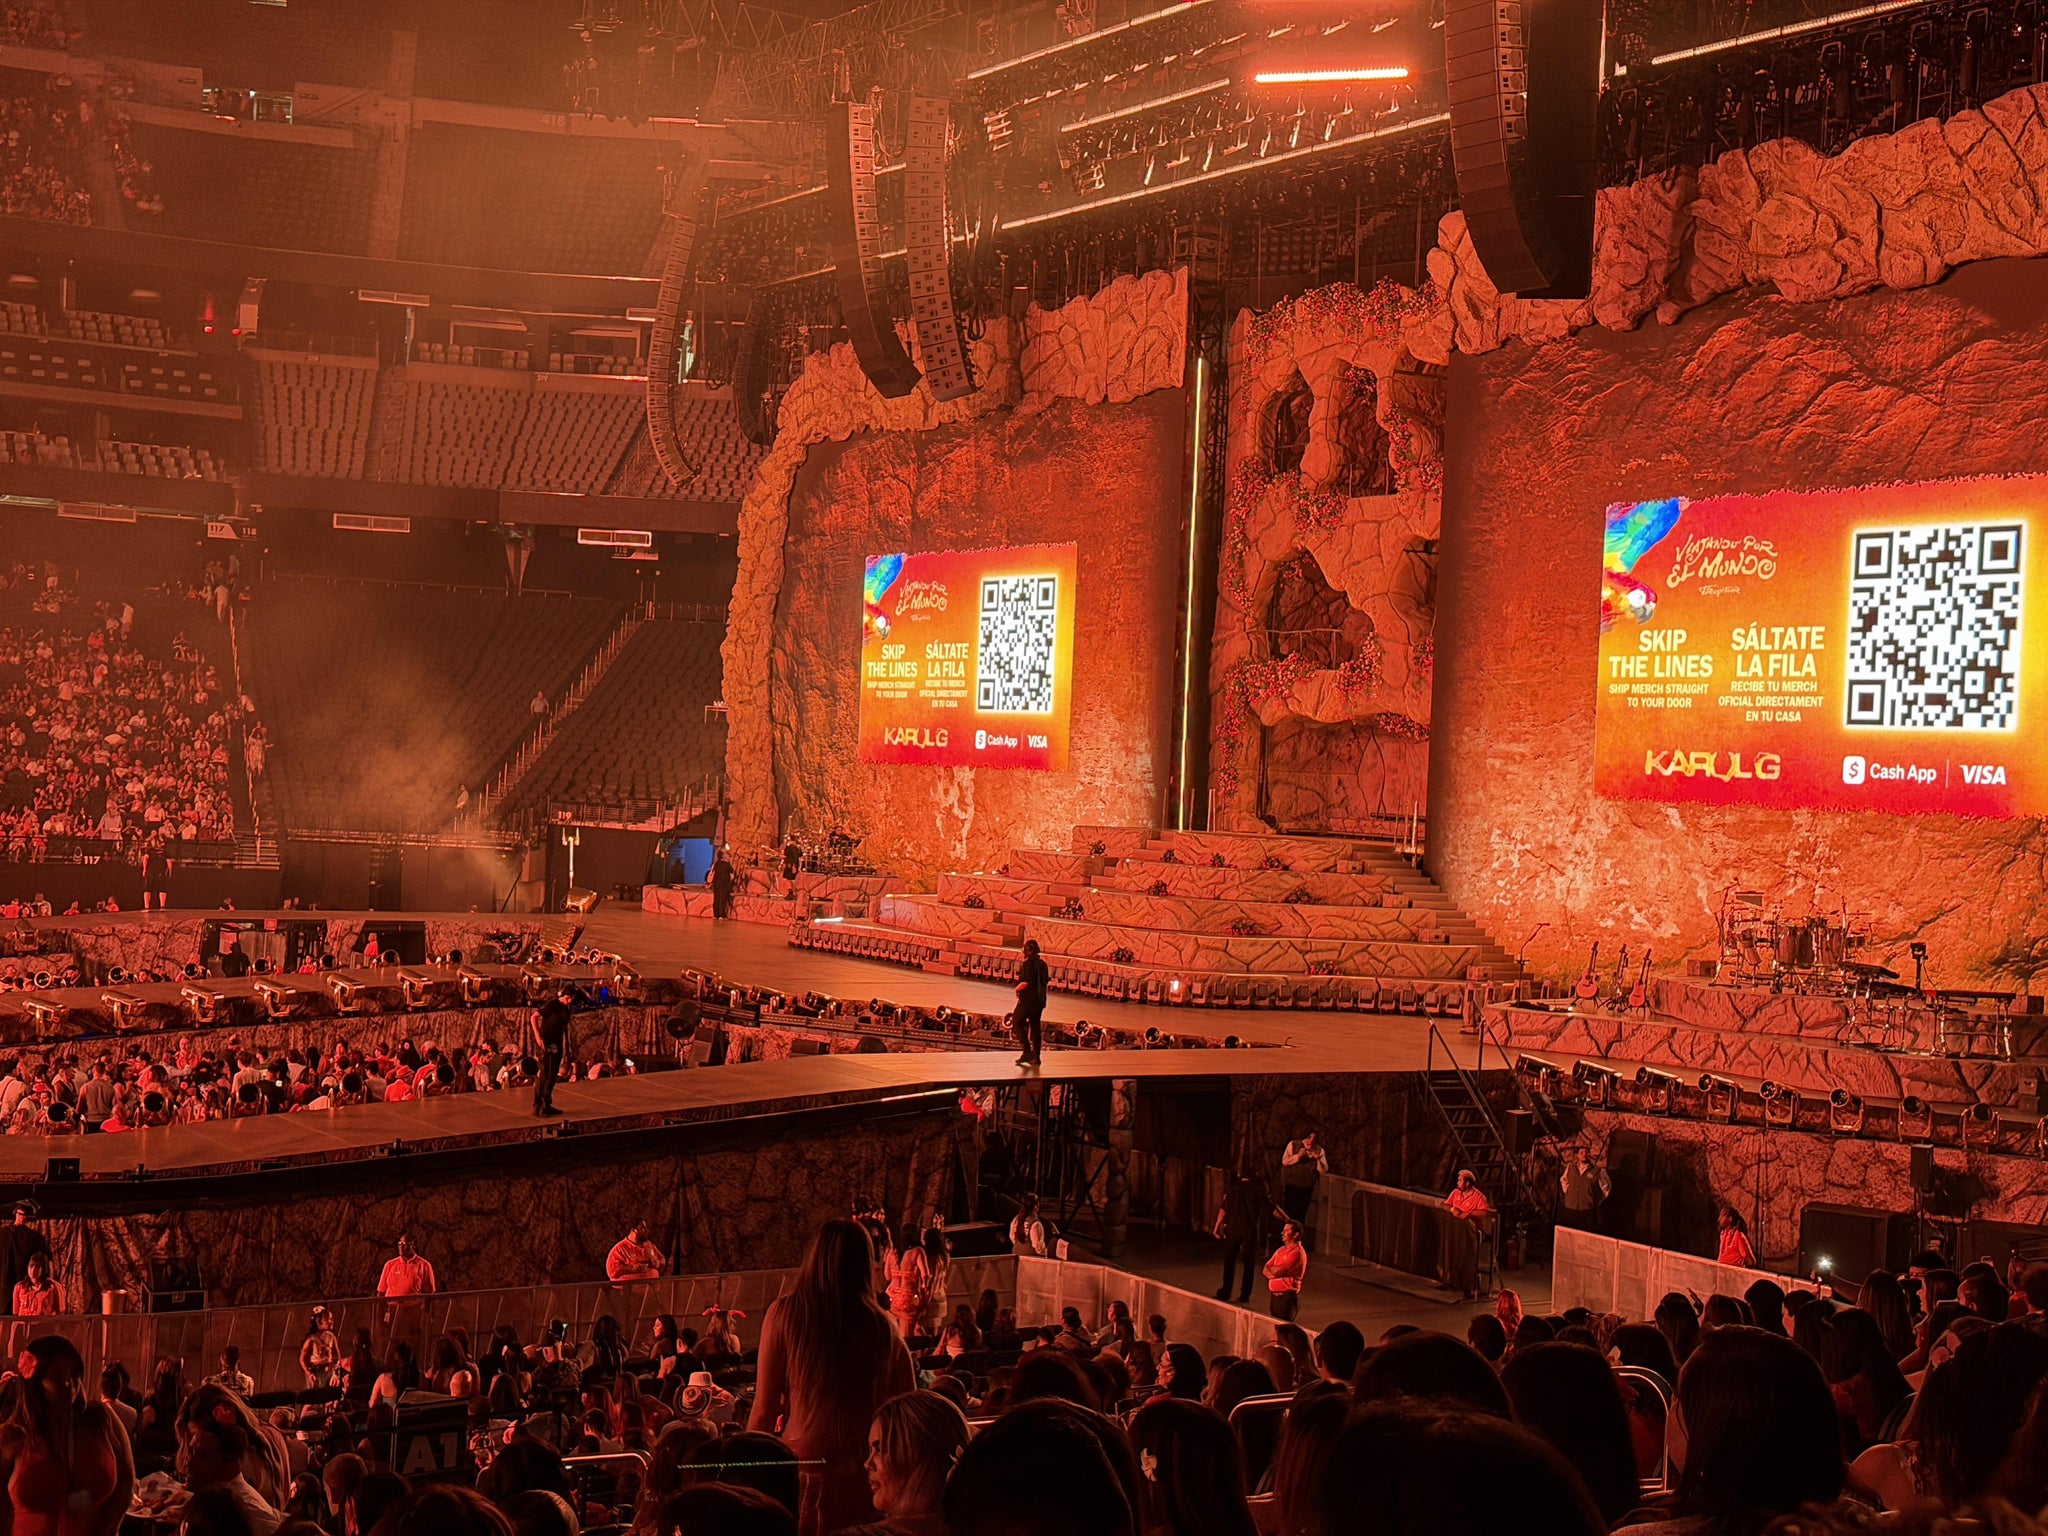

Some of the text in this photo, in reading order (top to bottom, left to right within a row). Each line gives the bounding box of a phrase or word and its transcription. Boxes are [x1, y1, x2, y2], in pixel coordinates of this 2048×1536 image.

[1666, 550, 1777, 589] EL MUNDO
[1638, 628, 1687, 652] SKIP
[1730, 621, 1826, 651] SÁLTATE
[881, 644, 906, 660] SKIP
[925, 640, 970, 660] SÁLTATE
[867, 661, 918, 678] THE LINES
[927, 661, 966, 678] LA FILA
[1608, 654, 1714, 678] THE LINES
[1735, 652, 1817, 677] LA FILA
[1608, 683, 1709, 694] SHIP MERCH STRAIGHT
[1730, 681, 1818, 692] RECIBE TU MERCH
[1627, 697, 1692, 708] TO YOUR DOOR
[1718, 695, 1824, 707] OFICIAL DIRECTAMENT
[1745, 711, 1802, 722] EN TU CASA
[935, 727, 949, 748] G
[987, 735, 1004, 745] Cash
[1004, 736, 1018, 748] App
[1027, 734, 1048, 749] VISA
[1754, 752, 1781, 780] G
[1869, 763, 1905, 780] Cash
[1907, 765, 1937, 784] App
[1959, 764, 2007, 786] VISA
[83, 855, 101, 865] 117
[402, 1431, 458, 1474] A1
